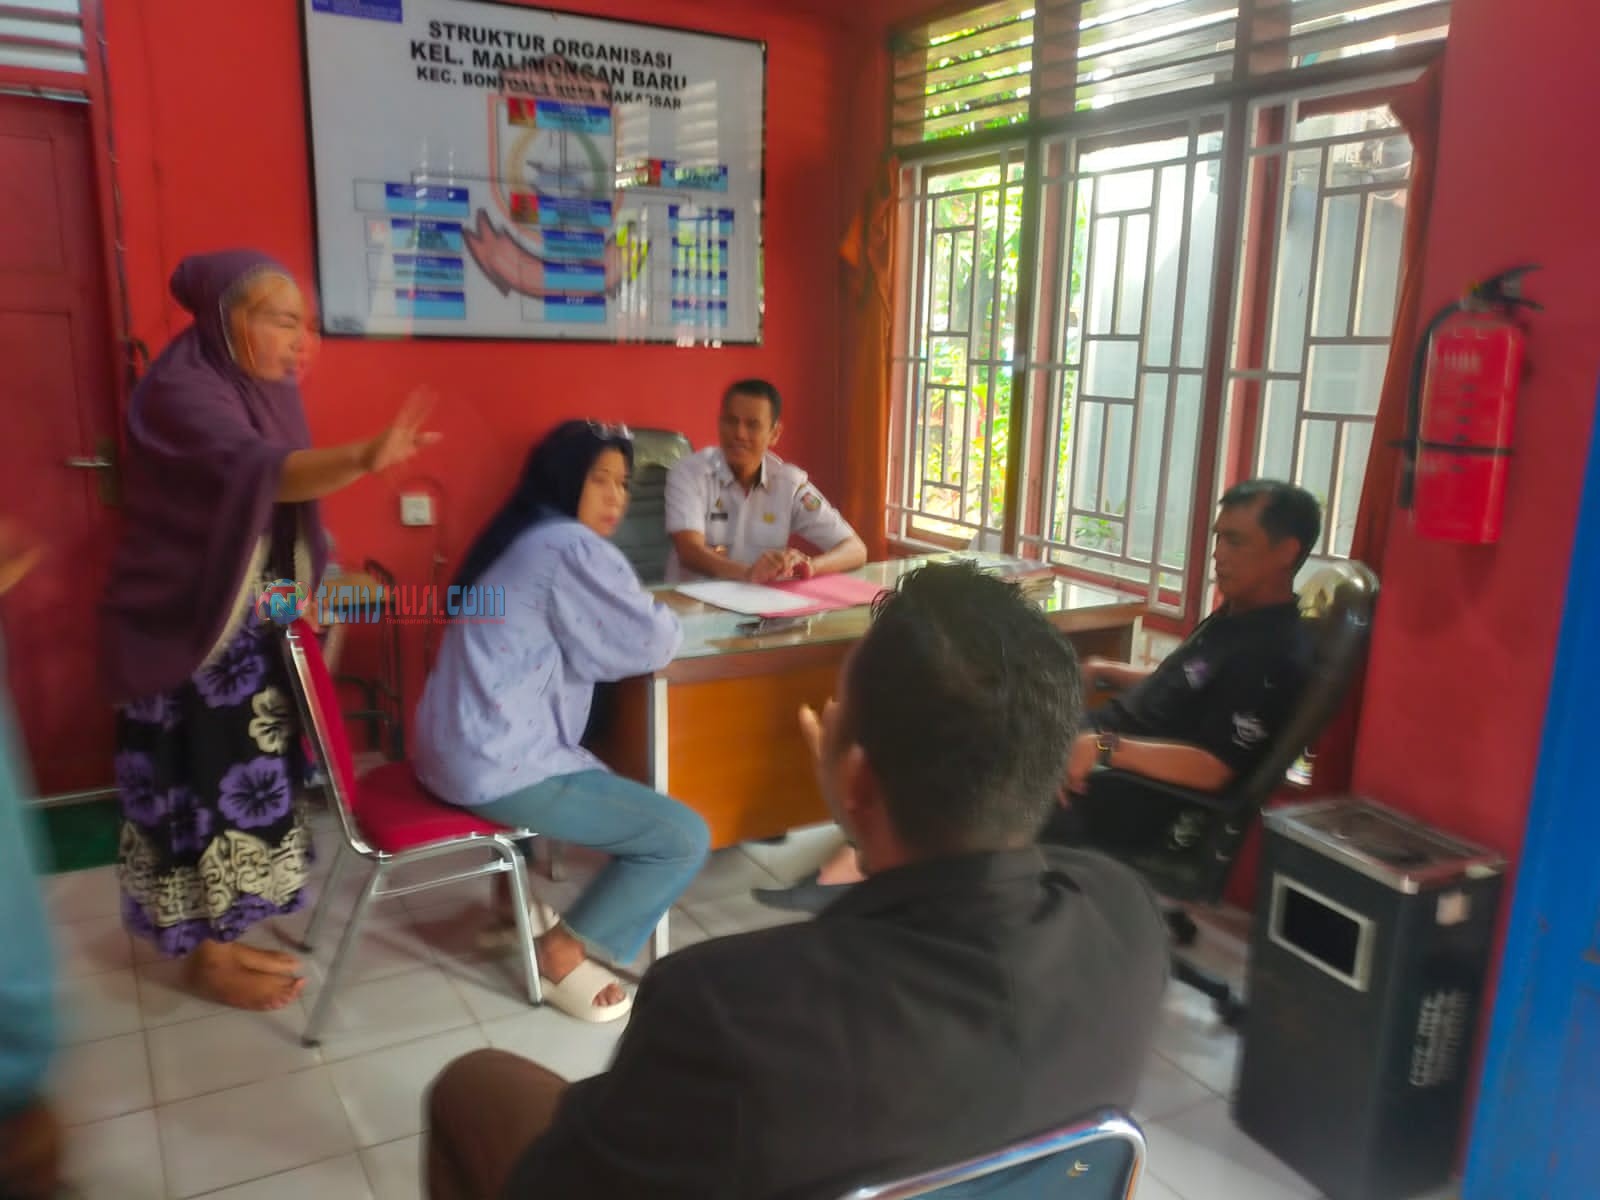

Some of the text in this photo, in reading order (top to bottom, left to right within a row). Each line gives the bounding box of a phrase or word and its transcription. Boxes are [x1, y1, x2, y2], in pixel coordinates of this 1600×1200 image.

[410, 40, 464, 65] KEL.
[633, 67, 687, 91] BARU
[429, 21, 673, 69] STRUKTUR ORGANISASI
[416, 66, 457, 84] KEC.
